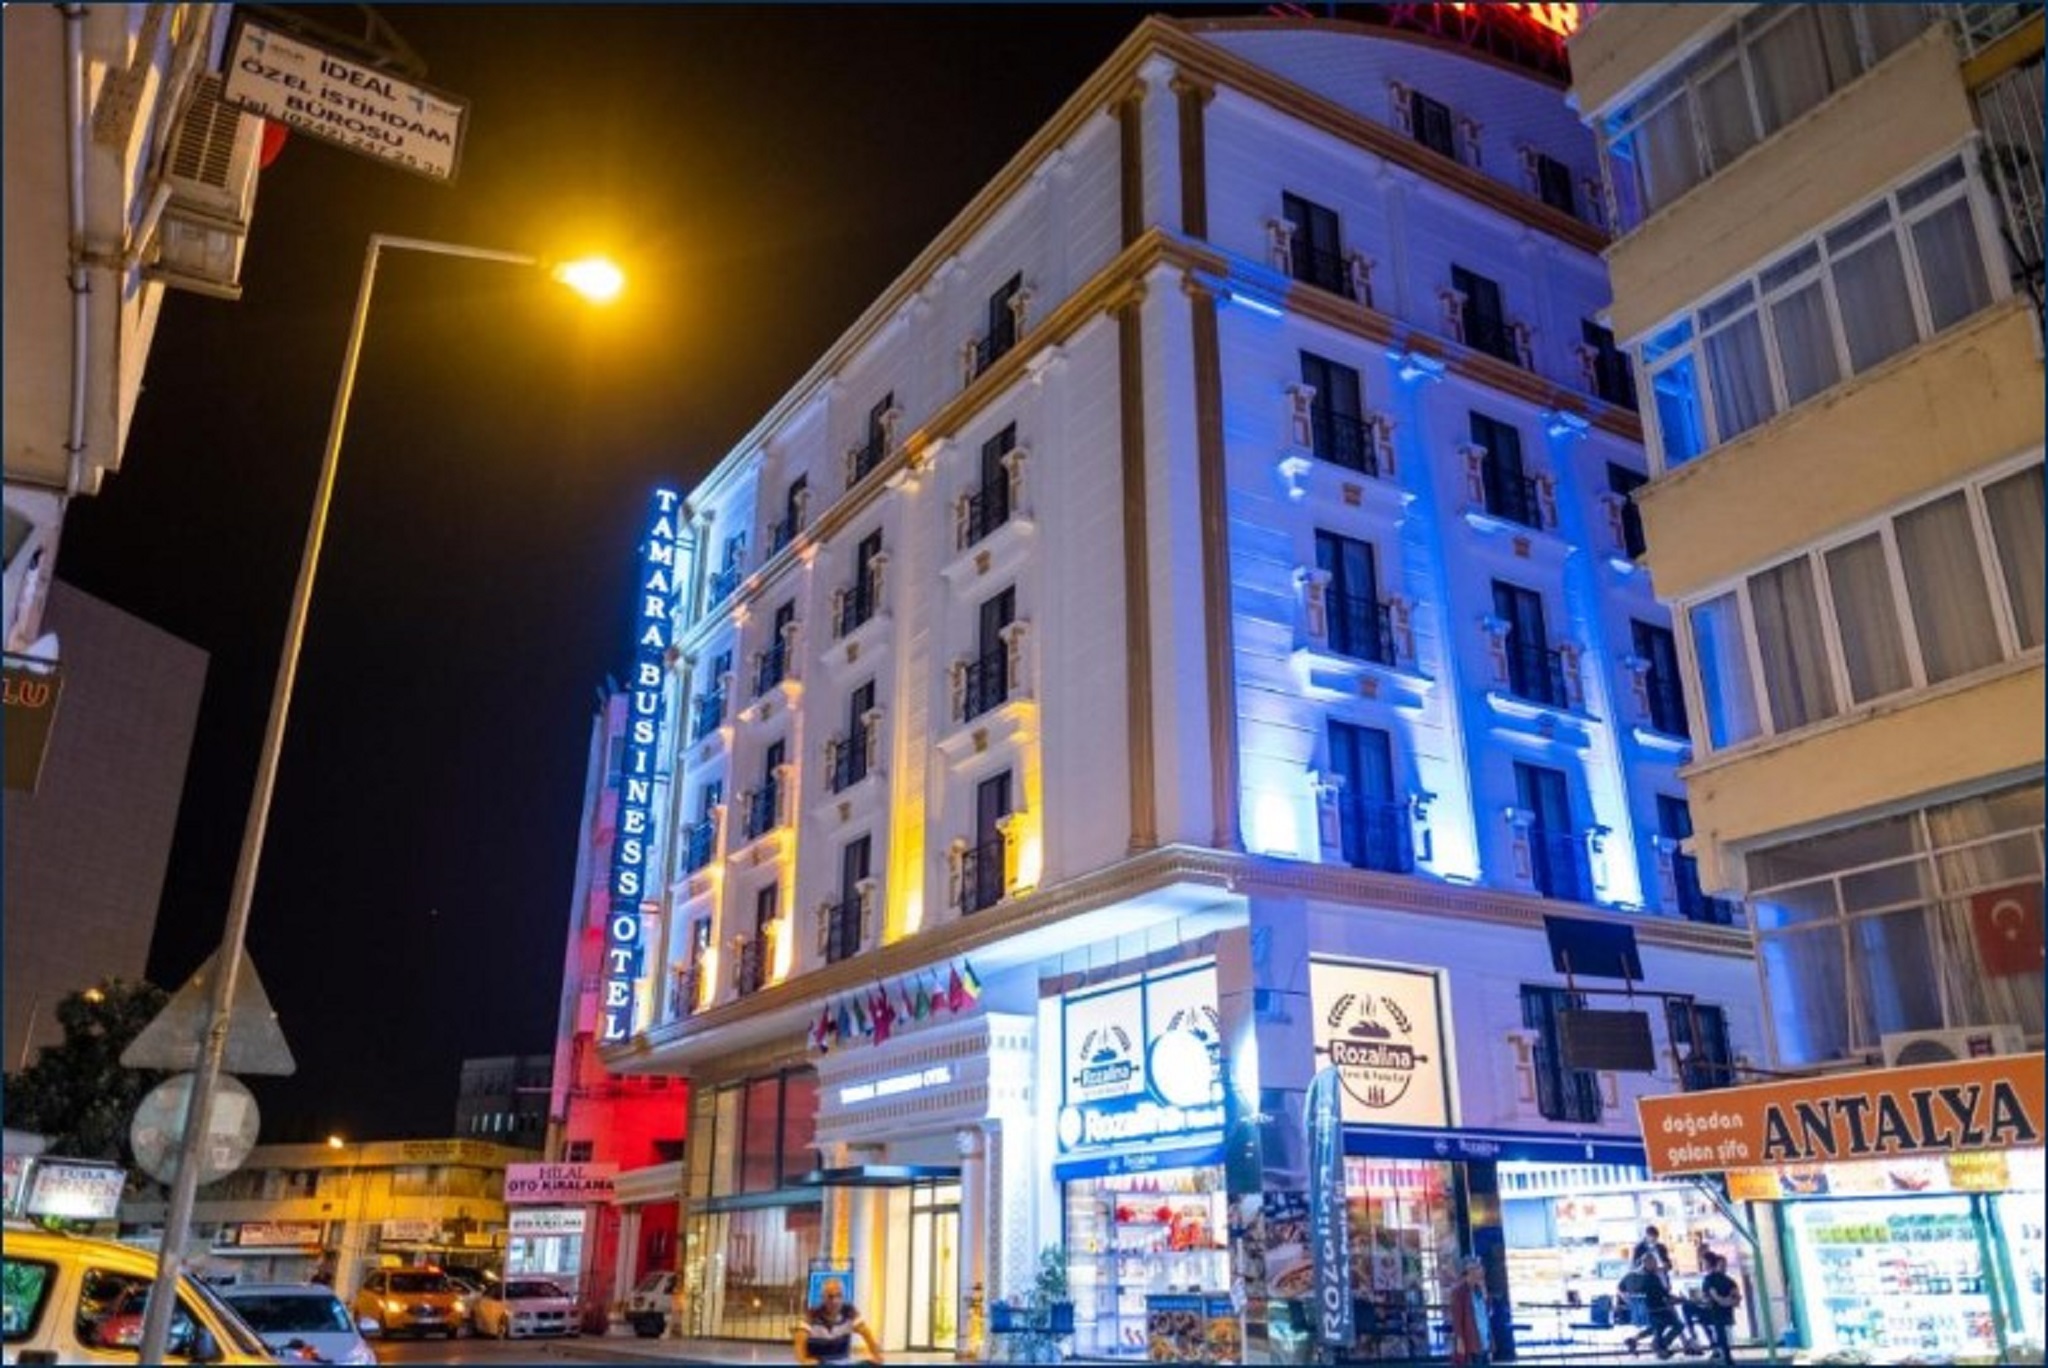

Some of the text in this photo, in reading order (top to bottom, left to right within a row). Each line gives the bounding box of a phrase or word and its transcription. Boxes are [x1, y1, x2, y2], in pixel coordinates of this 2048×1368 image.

[241, 57, 312, 95] ÖZEL
[285, 94, 404, 148] BÜROSU
[605, 488, 677, 1041] TAMARA BUSINESS OTEL
[1331, 1041, 1411, 1069] Rozalina
[1763, 1081, 2036, 1161] ANTALYA
[508, 1180, 539, 1192] OTO
